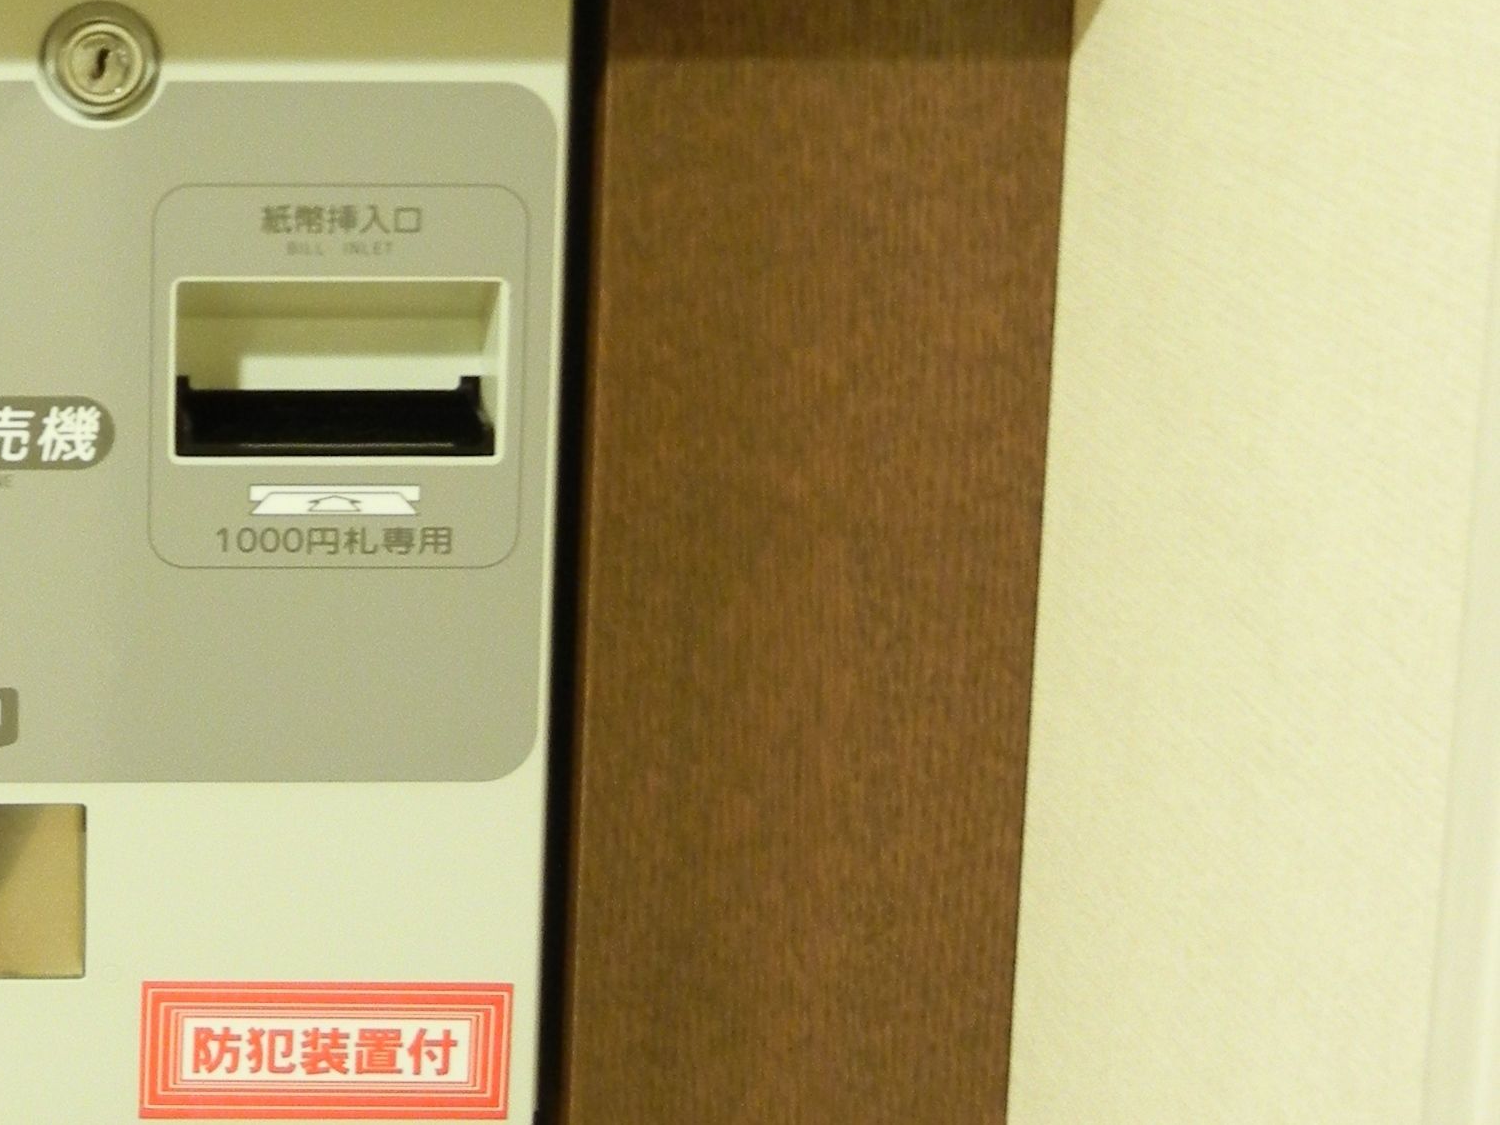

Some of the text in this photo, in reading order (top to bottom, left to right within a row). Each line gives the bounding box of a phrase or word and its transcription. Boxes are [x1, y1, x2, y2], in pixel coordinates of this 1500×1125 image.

[260, 204, 423, 235] 紙幣挿入口
[285, 241, 394, 256] BILL INLET
[216, 526, 453, 556] 1000円札専用
[192, 1026, 459, 1076] 防犯装置付
